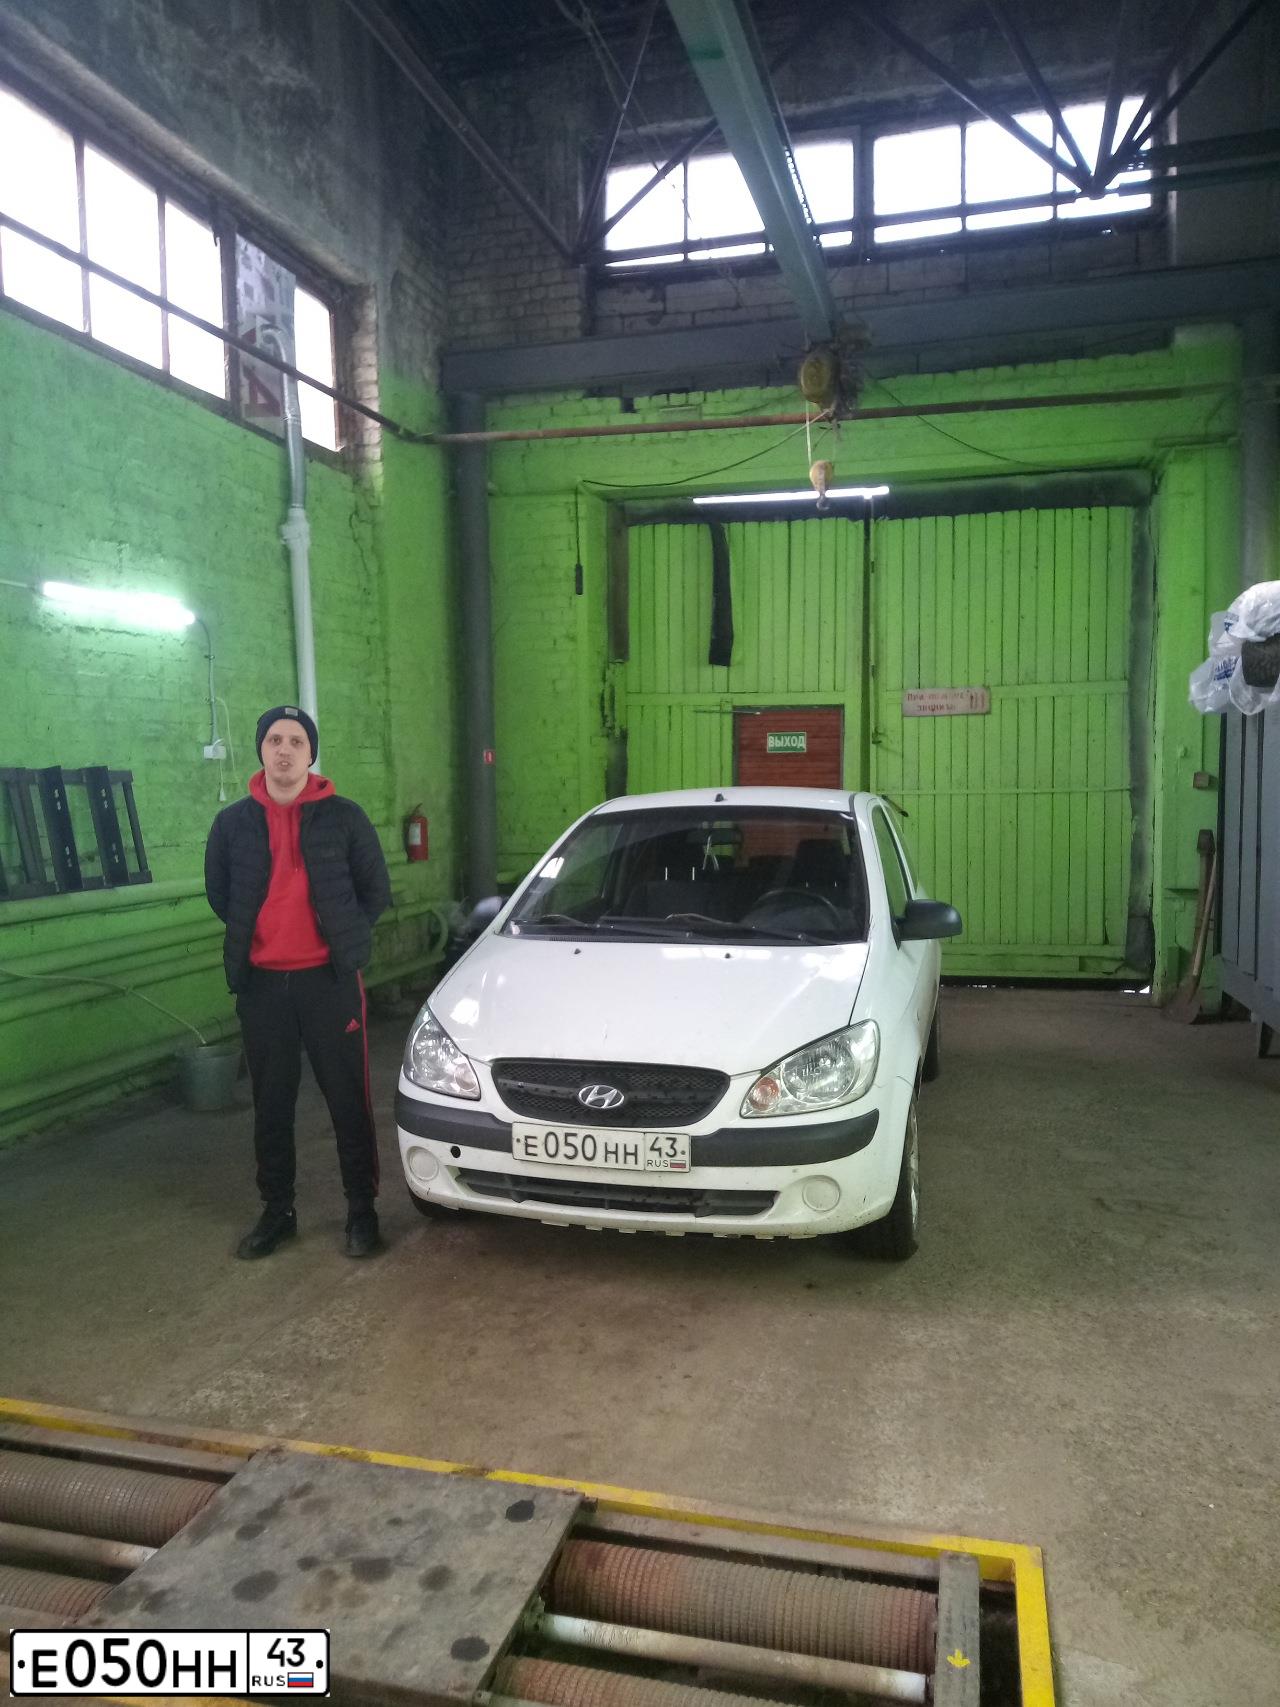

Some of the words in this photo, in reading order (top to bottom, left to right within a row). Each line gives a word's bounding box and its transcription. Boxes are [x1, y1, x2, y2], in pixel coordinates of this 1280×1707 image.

[768, 735, 805, 749] ВЫХОД
[650, 1136, 678, 1158] 43
[647, 1159, 668, 1168] RUS
